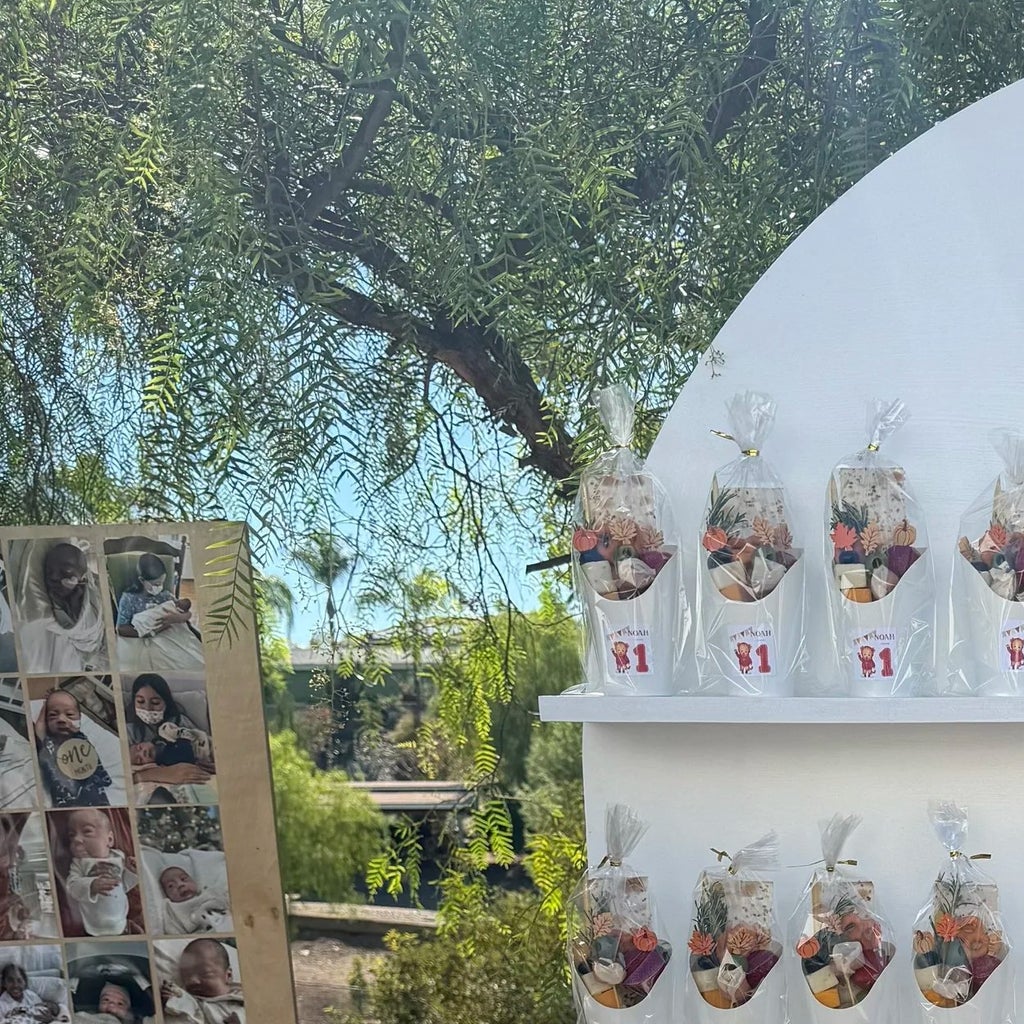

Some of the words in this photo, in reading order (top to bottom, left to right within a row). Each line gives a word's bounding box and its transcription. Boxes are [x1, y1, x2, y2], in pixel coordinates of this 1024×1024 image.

[627, 629, 649, 637] NOAH
[750, 629, 772, 638] NOAH
[874, 633, 895, 641] NOAH
[633, 643, 649, 673] 1
[755, 644, 771, 673] 1
[879, 647, 894, 677] 1
[61, 744, 92, 764] one
